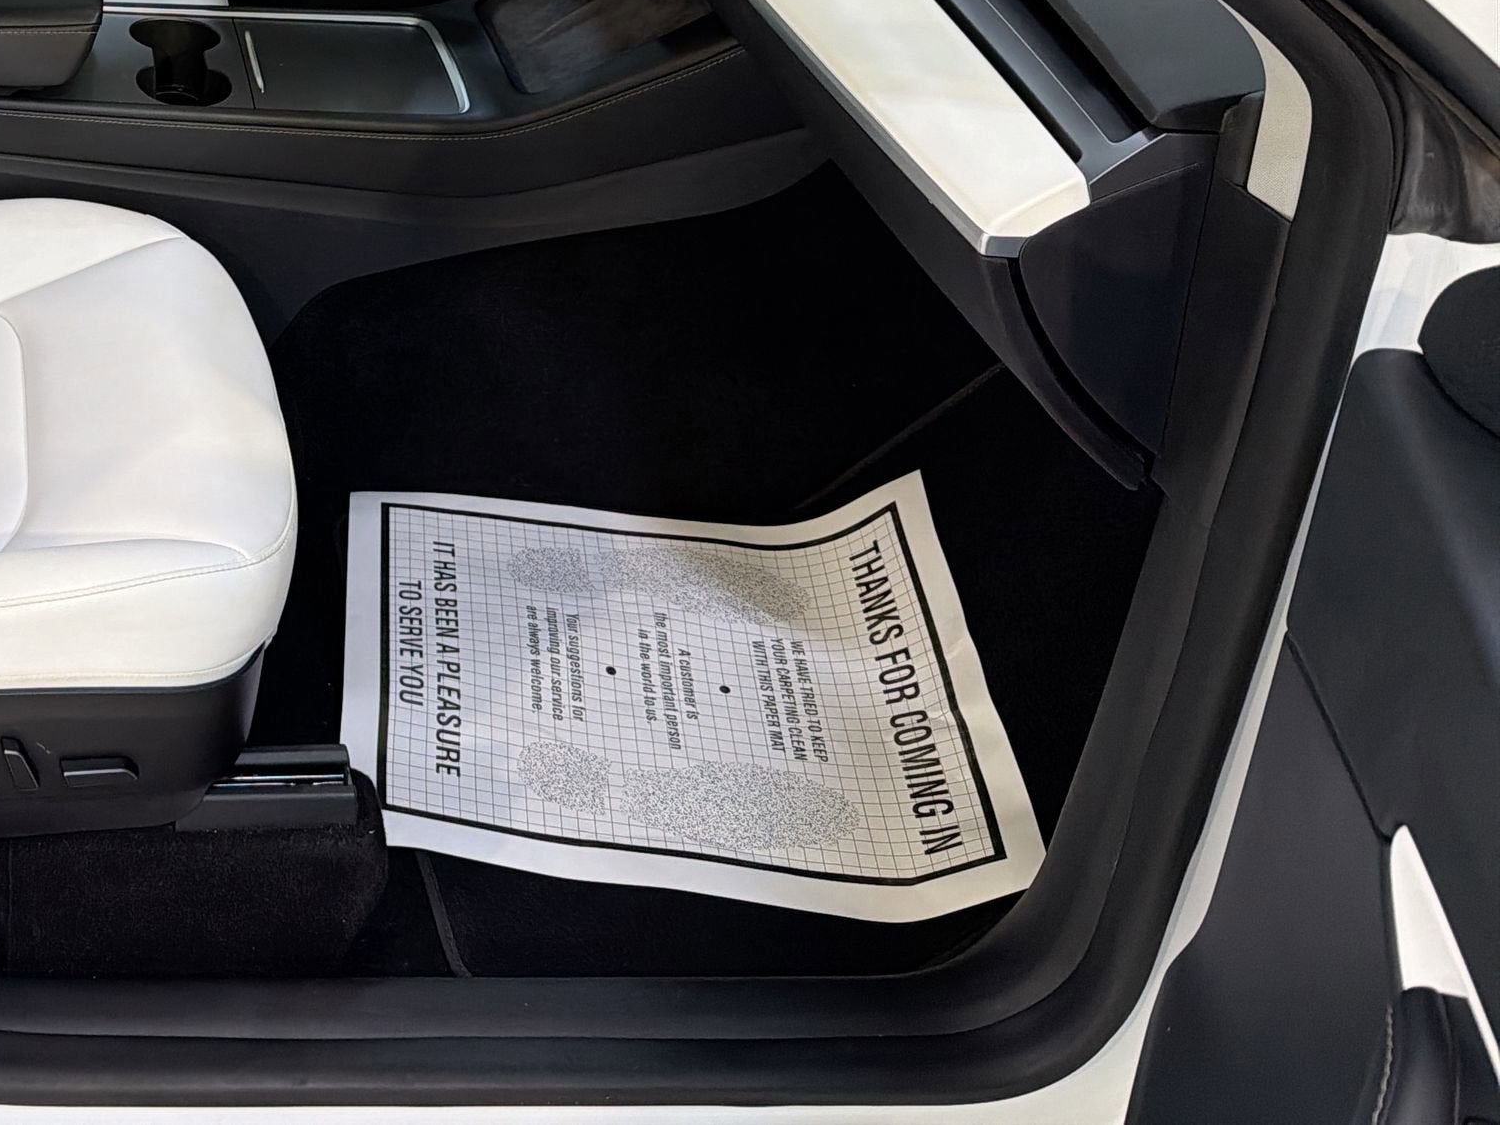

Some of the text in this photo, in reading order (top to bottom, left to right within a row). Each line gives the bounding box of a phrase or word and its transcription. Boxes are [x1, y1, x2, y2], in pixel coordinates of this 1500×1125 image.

[399, 581, 424, 706] TO SERVE YOU
[433, 541, 461, 777] IT HAS BEEN A PLEASURE
[526, 605, 544, 713] are always welcome.
[546, 607, 565, 720] improving our service
[566, 614, 585, 721] Your suggestions for
[638, 629, 657, 724] in the world to us.
[654, 611, 682, 750] the most important person
[678, 648, 699, 720] A customer is
[752, 641, 785, 753] WITH THIS PAPER MAT
[770, 638, 808, 761] YOUR CARPETING CLEAN
[791, 641, 828, 762] WE HAVE TRIED TO KEEP
[849, 540, 963, 855] THANKS FOR COMING IN
